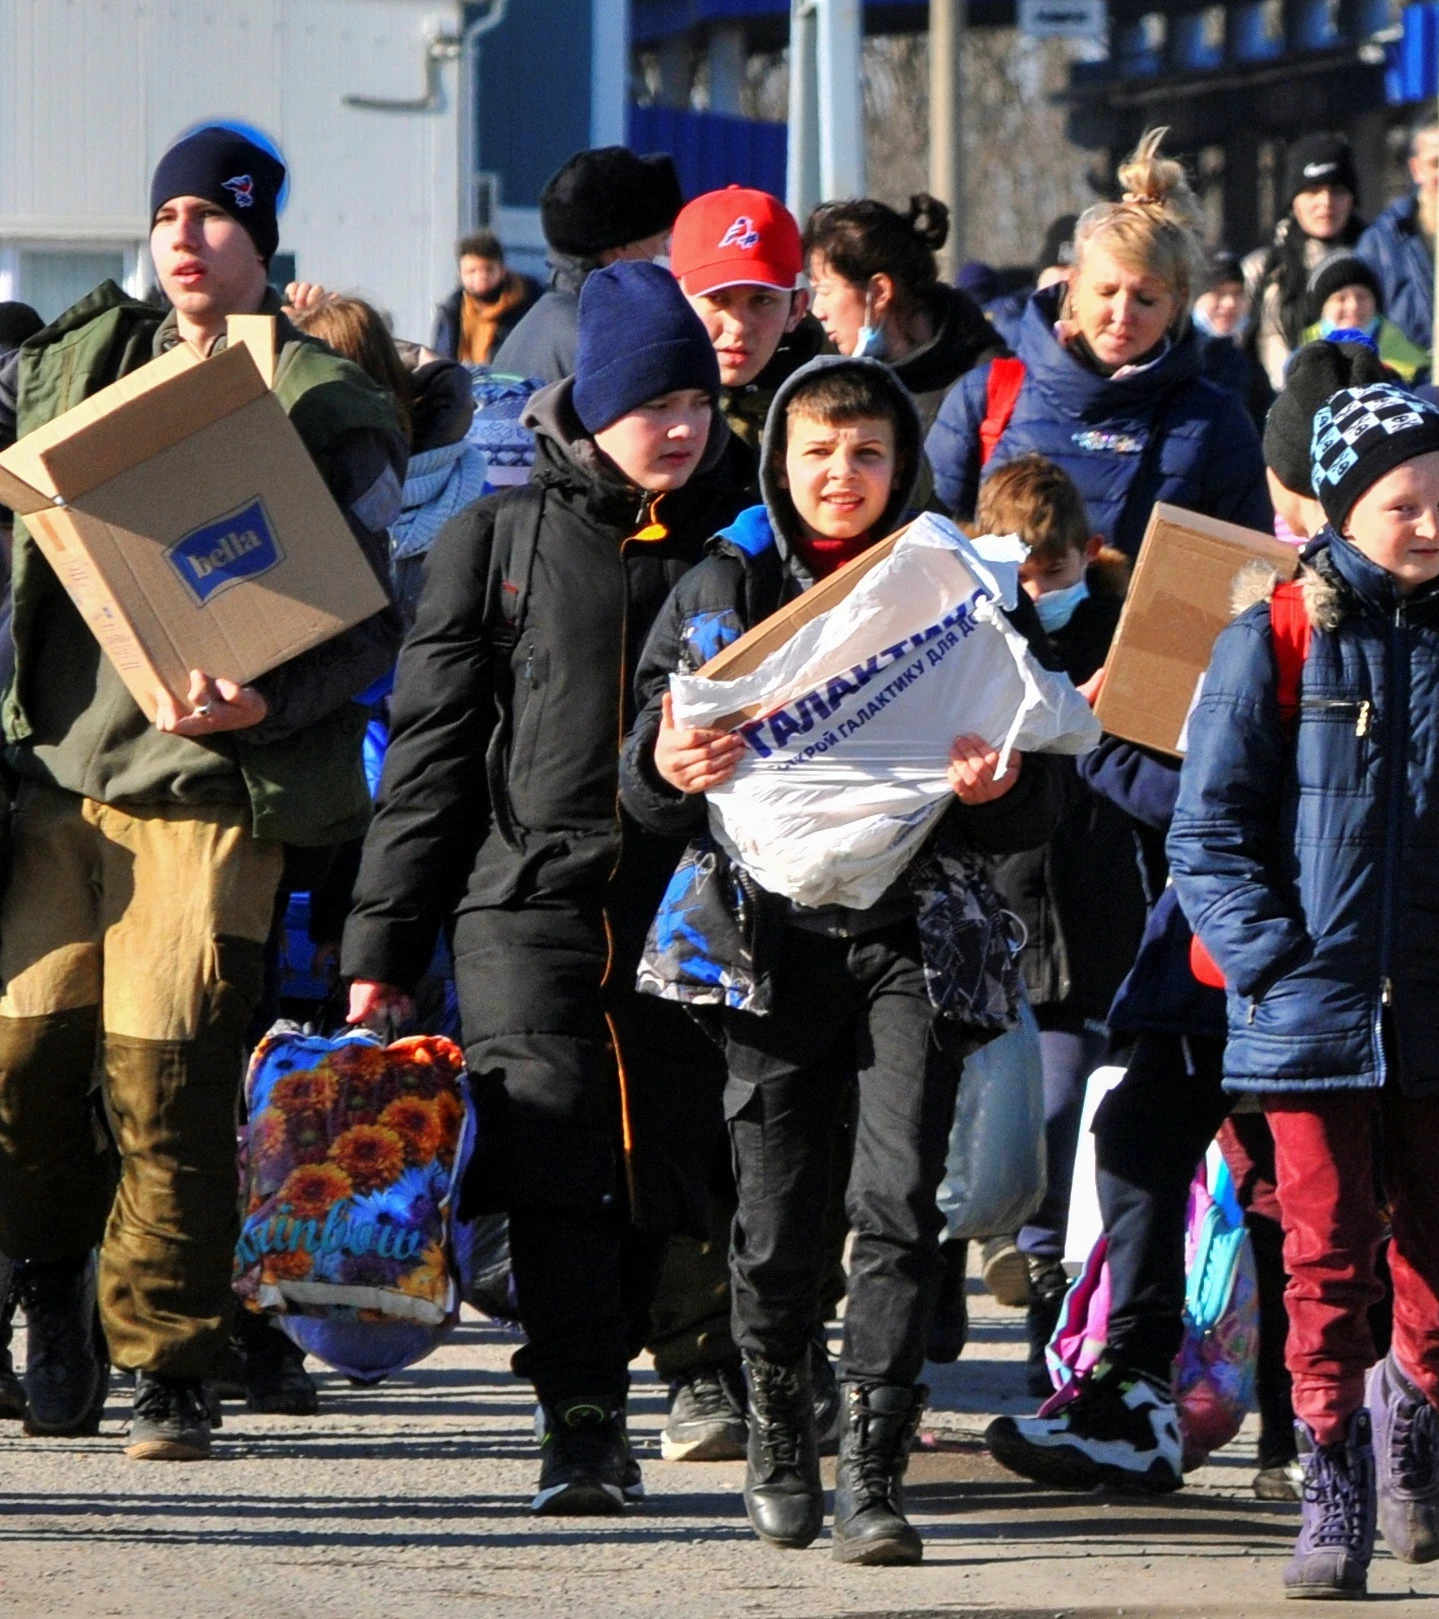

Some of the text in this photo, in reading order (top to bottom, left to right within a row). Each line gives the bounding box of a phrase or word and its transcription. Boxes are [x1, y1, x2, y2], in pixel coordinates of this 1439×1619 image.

[187, 530, 262, 579] bella
[836, 658, 926, 739] ГАЛАКТИКУ
[926, 633, 961, 668] ДЛЯ
